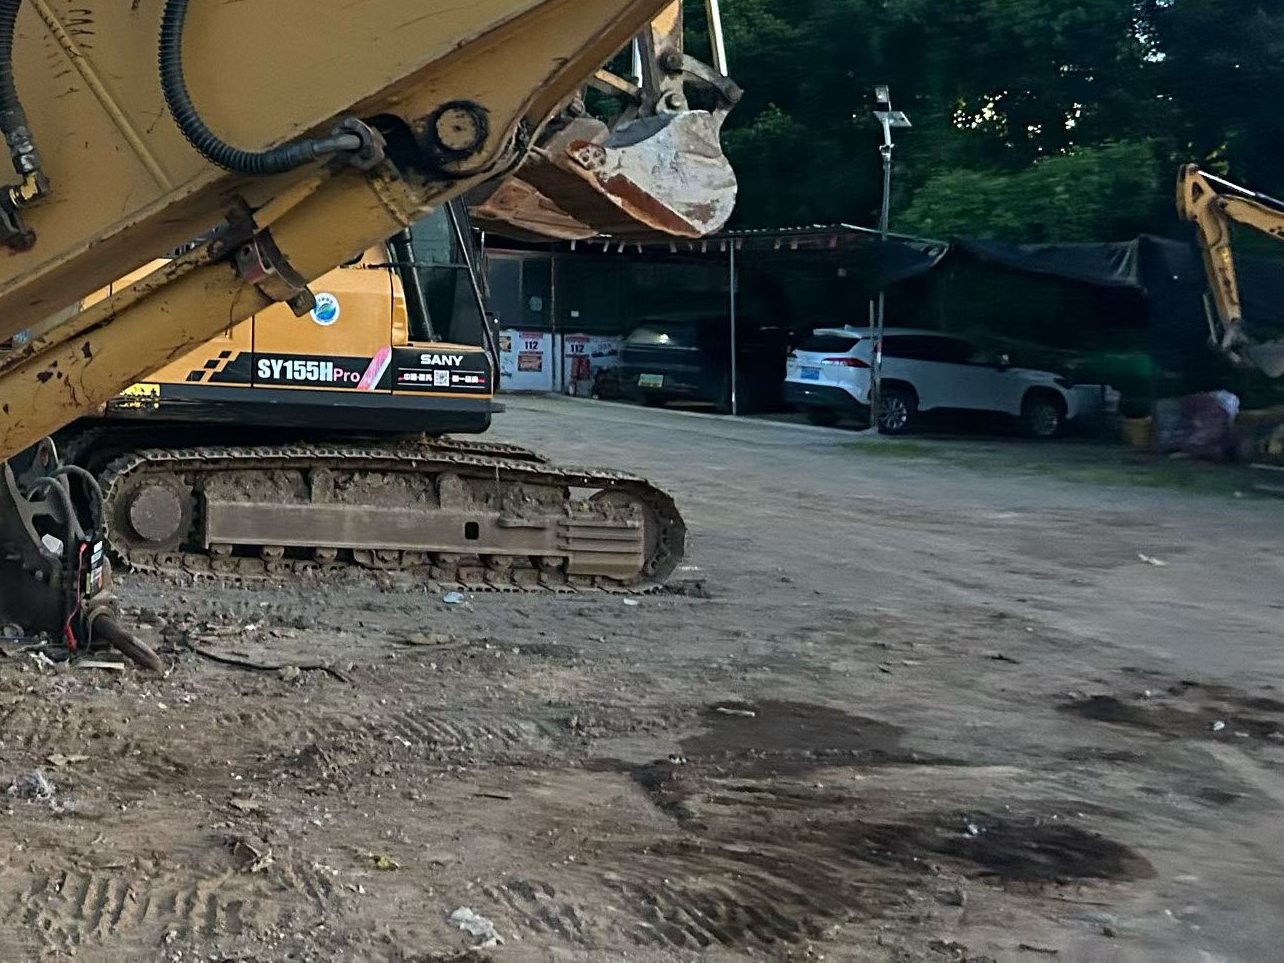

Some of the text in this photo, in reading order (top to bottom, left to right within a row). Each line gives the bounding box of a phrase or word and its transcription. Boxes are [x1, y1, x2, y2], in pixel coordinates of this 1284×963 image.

[524, 340, 539, 350] 112
[570, 343, 585, 353] 112
[420, 353, 464, 366] SANY
